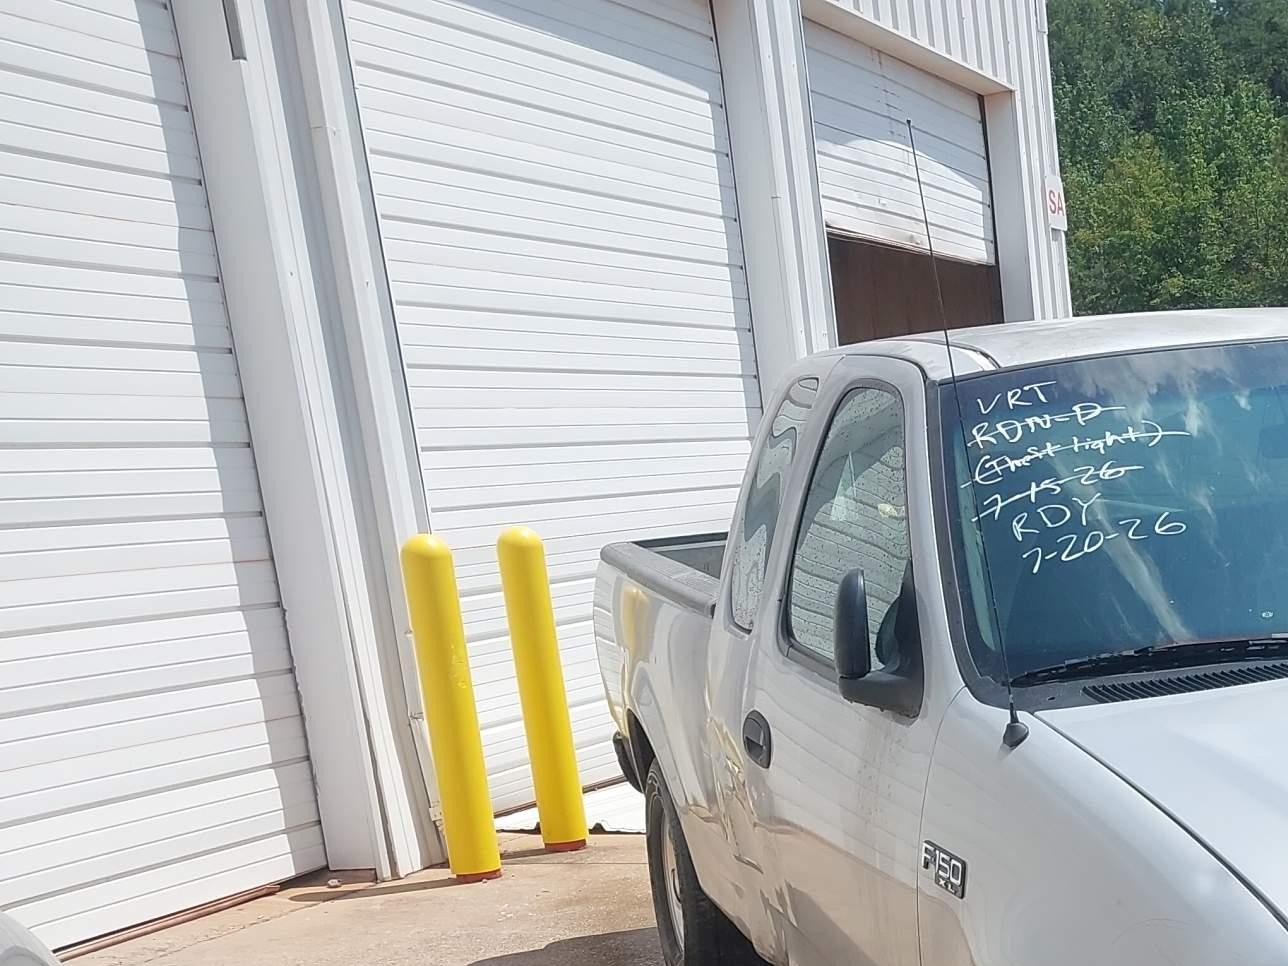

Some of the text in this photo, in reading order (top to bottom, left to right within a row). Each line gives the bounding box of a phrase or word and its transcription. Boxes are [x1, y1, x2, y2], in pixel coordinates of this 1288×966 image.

[977, 381, 1057, 414] VRT
[1012, 493, 1102, 541] RDY
[1022, 511, 1187, 573] 7-20-26
[938, 877, 955, 894] XL
